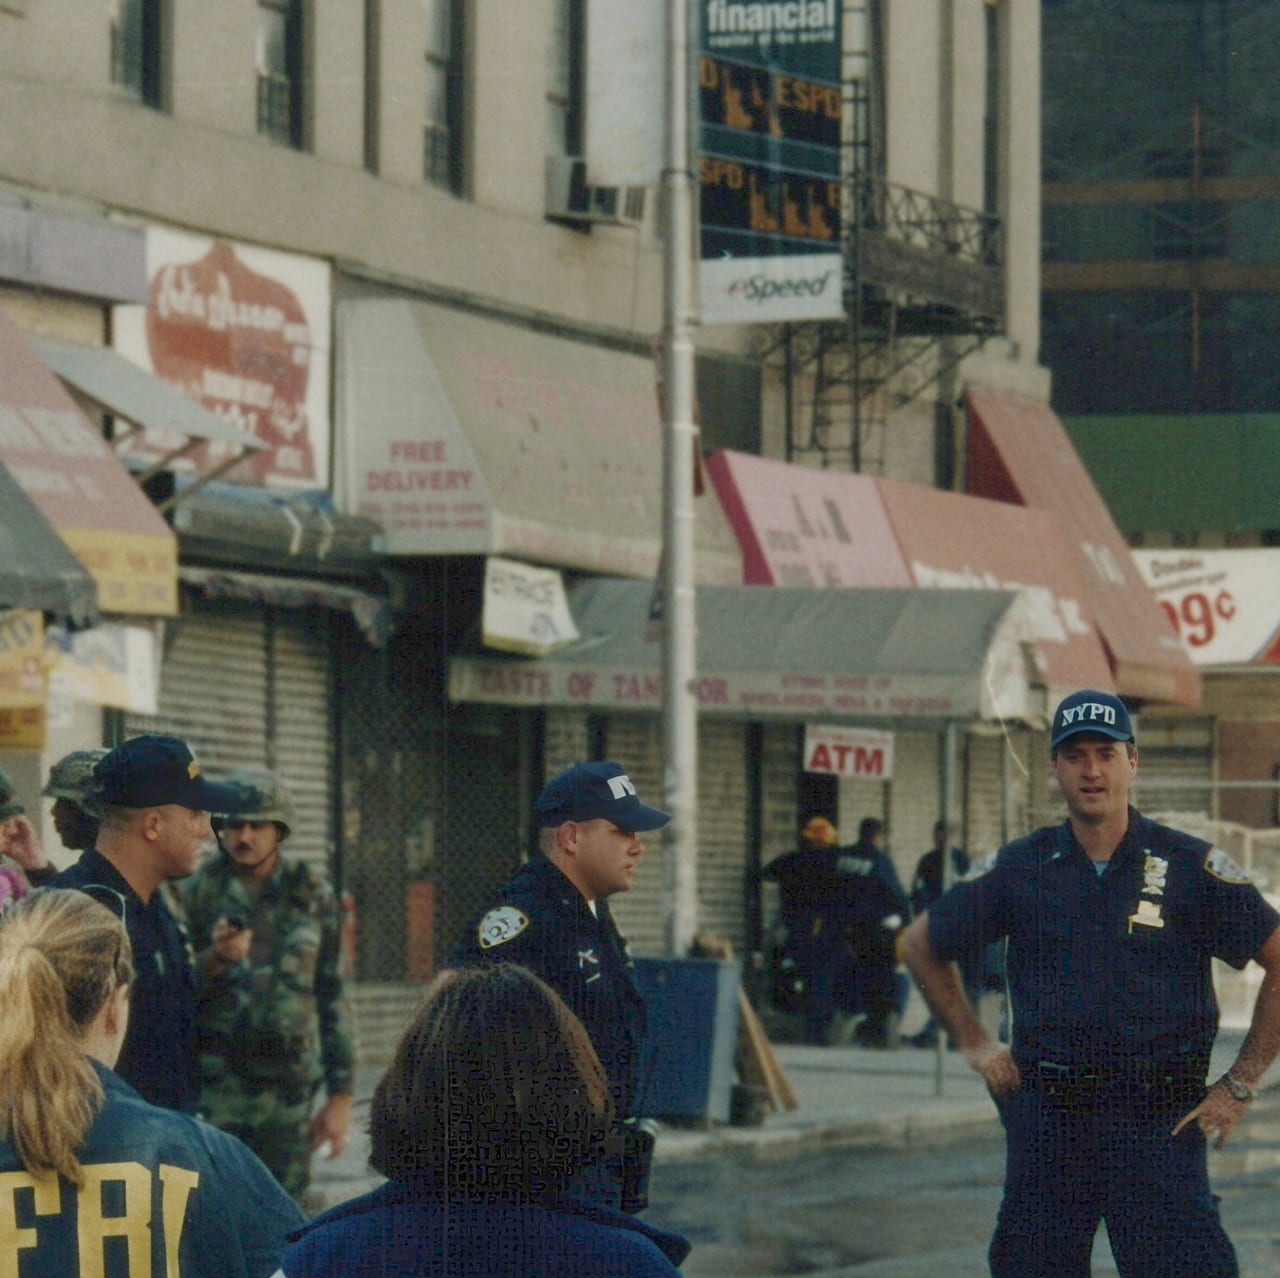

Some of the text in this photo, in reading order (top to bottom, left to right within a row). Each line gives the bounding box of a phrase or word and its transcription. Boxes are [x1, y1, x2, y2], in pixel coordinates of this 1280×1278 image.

[707, 0, 836, 33] financial
[728, 271, 830, 303] eSpeed
[389, 441, 446, 463] FREE
[366, 470, 473, 492] DELIVERY
[1061, 702, 1117, 727] NYPD
[808, 742, 885, 776] ATM
